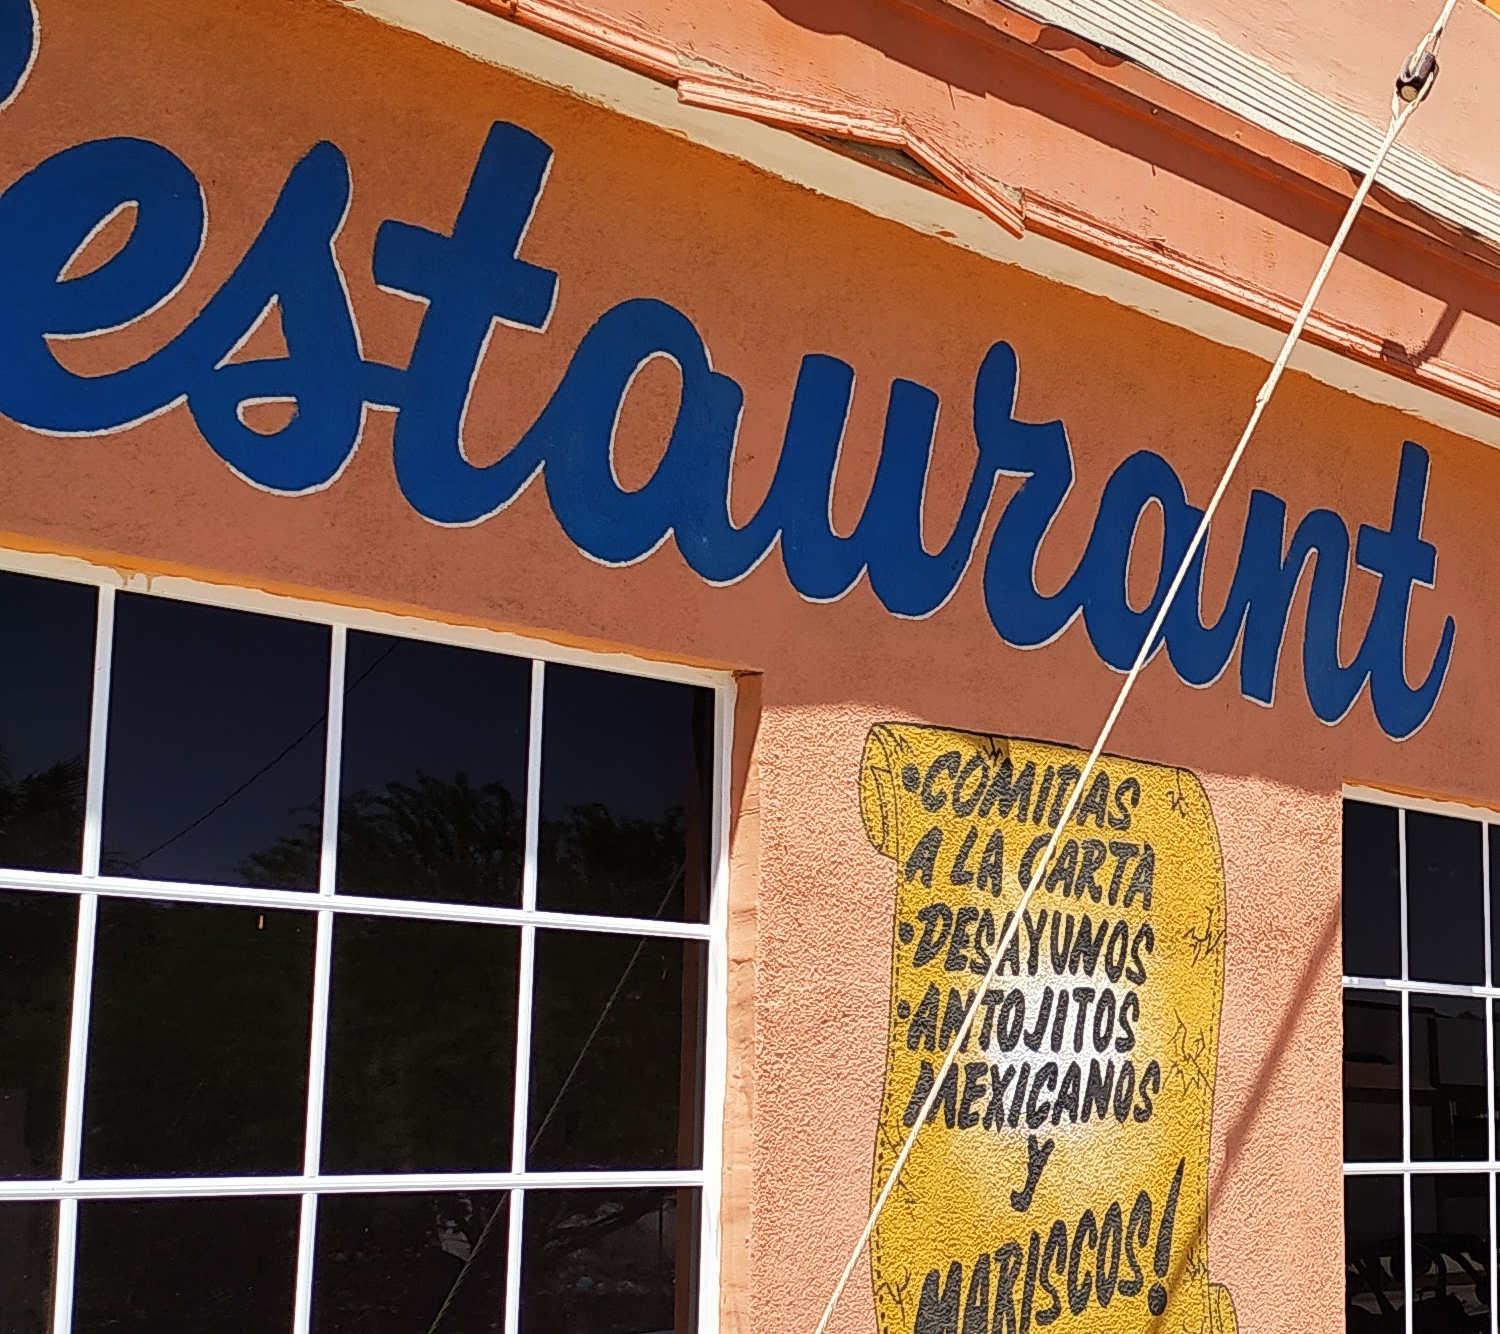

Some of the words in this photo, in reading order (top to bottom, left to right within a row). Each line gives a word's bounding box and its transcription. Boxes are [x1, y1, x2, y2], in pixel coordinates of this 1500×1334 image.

[920, 750, 1141, 830] COMIDAS
[904, 825, 944, 889] A
[949, 824, 1005, 899] LA
[1017, 832, 1156, 911] CARTA
[912, 903, 1155, 986] DESAYUNOS
[906, 985, 1141, 1054] ANTOJITOS
[902, 1058, 1161, 1134] MEXICANOS
